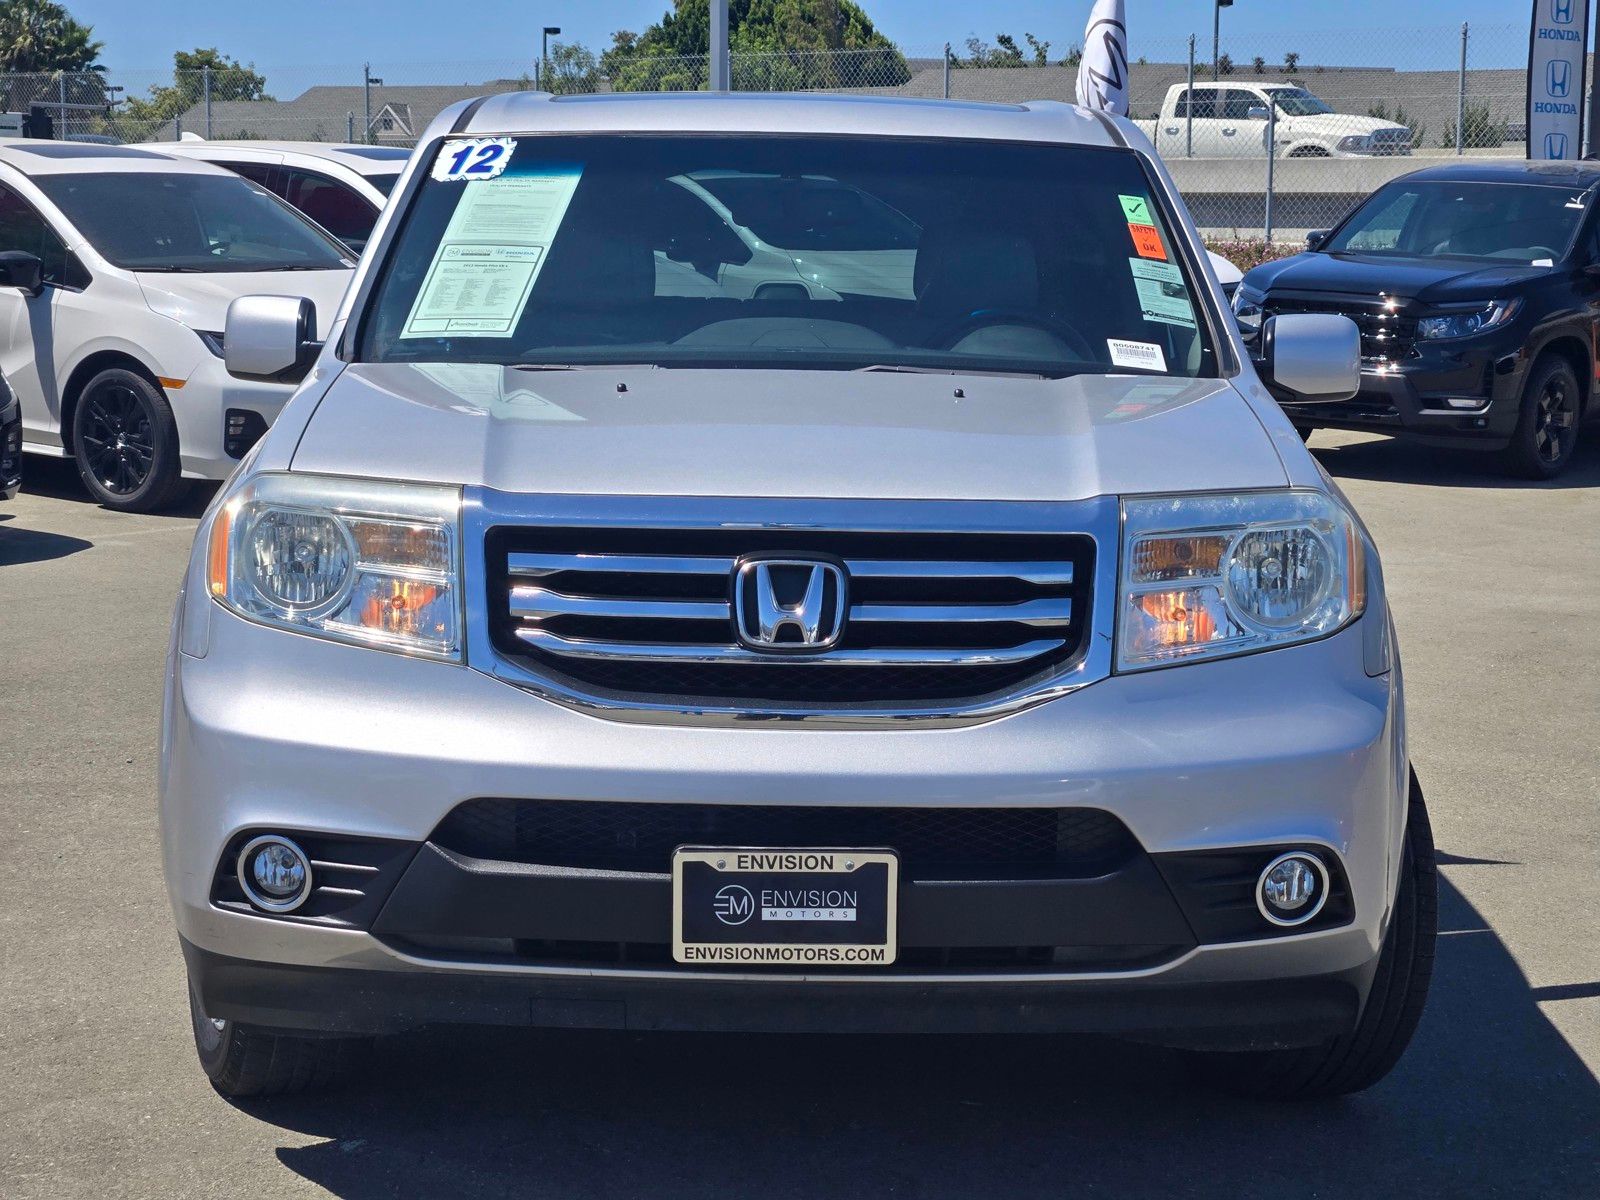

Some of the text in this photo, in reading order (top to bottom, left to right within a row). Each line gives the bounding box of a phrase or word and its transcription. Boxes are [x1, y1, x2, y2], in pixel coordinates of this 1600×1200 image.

[1538, 28, 1581, 42] HONDA
[1534, 101, 1578, 115] HONDA
[448, 144, 505, 175] 12
[1131, 225, 1156, 235] SAFETY
[1143, 243, 1157, 252] OK
[737, 855, 834, 870] ENVISION
[761, 890, 857, 907] ENVISION
[769, 910, 849, 918] MOTORS
[684, 946, 885, 961] ENVISIONMOTORS.COM
